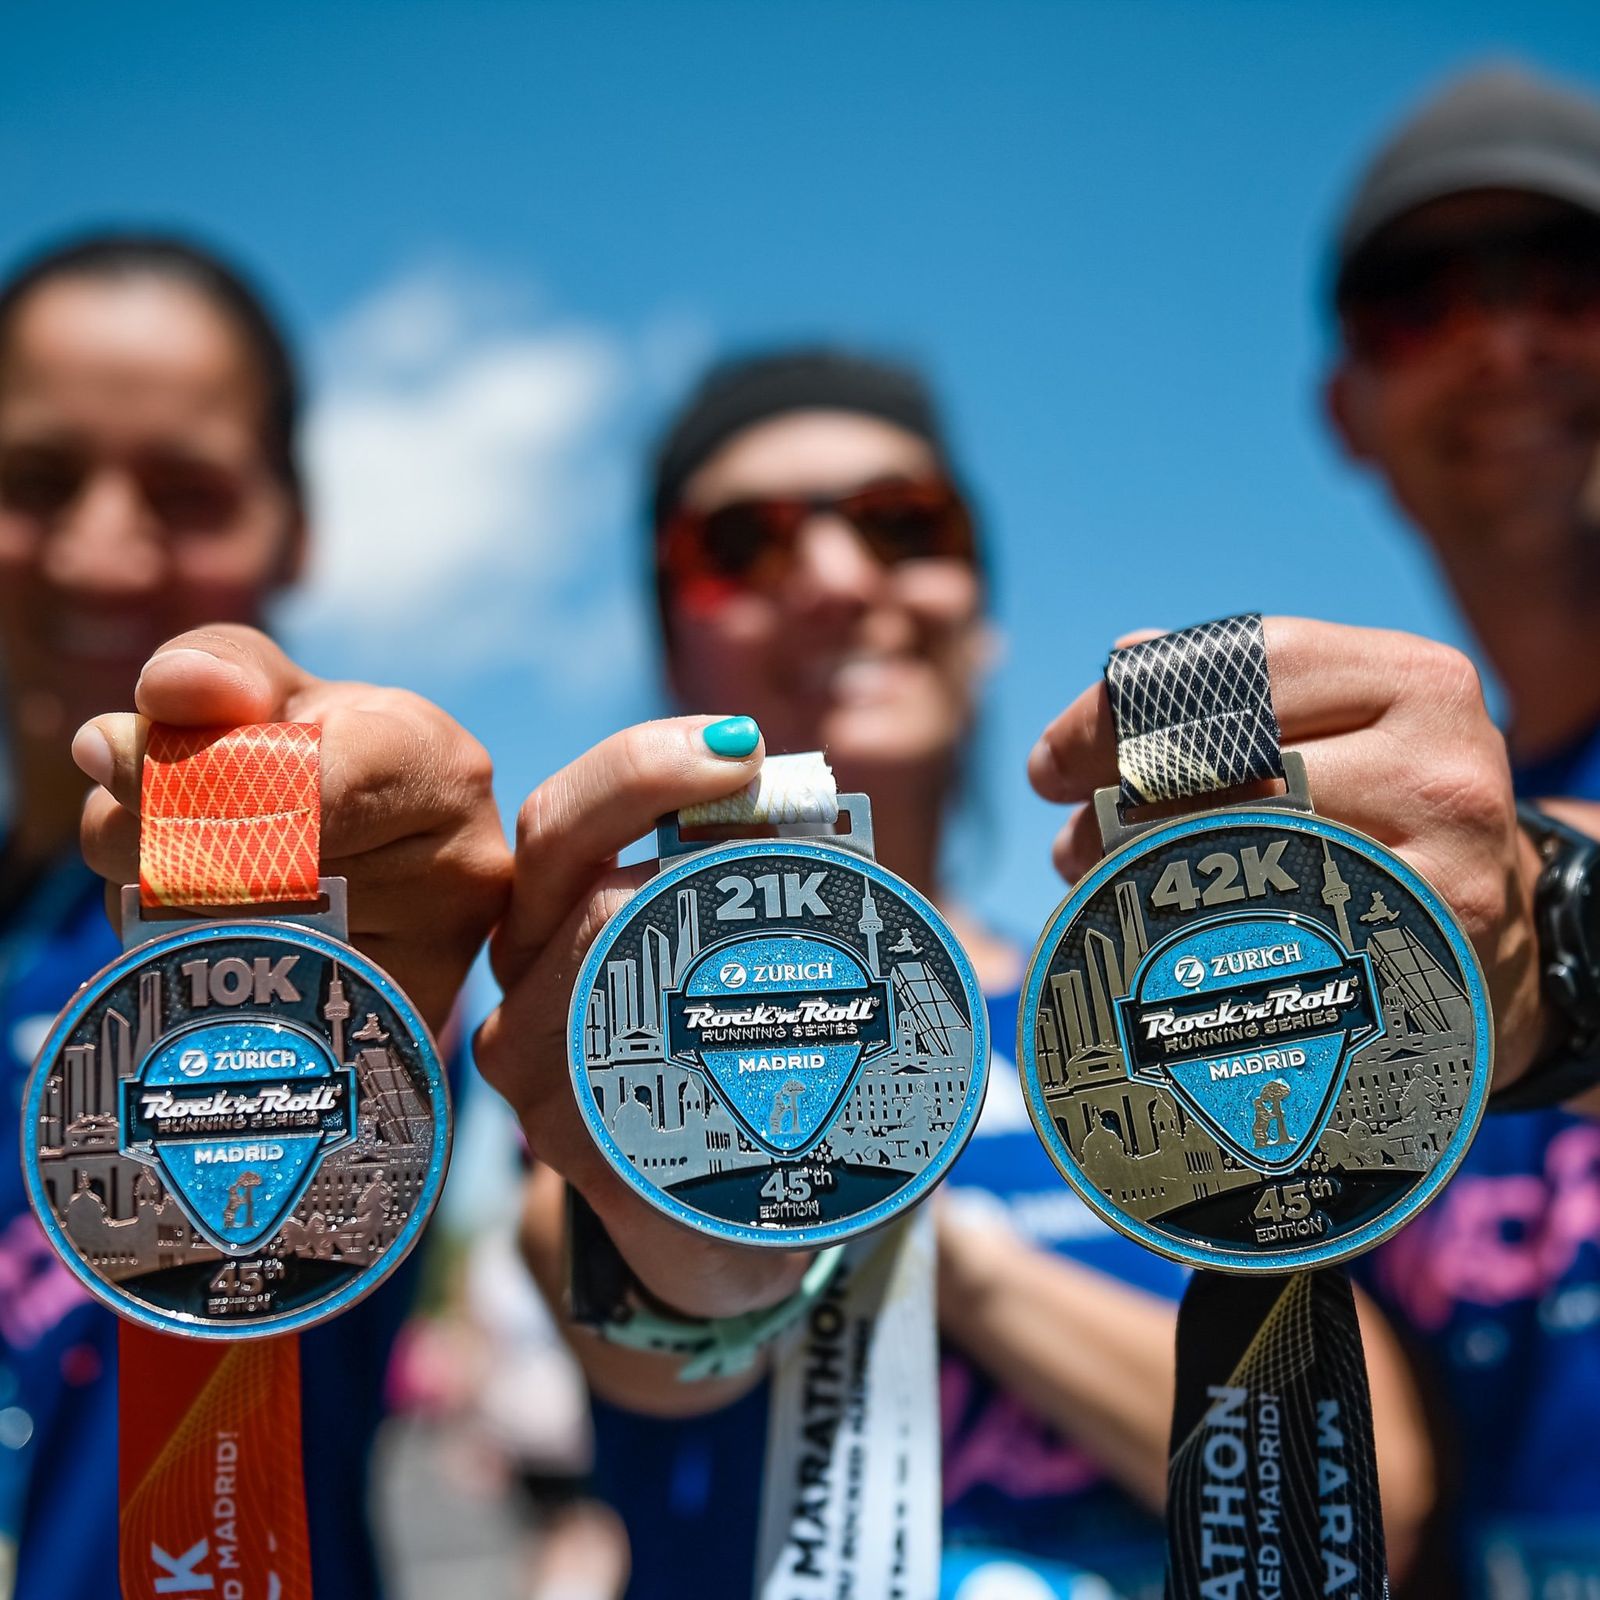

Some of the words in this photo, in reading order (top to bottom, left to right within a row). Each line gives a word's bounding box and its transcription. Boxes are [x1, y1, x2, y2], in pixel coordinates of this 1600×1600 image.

[1150, 839, 1299, 911] 42K
[715, 871, 832, 921] 21K
[752, 961, 834, 982] ZURICH
[1211, 942, 1303, 977] ZURICH
[181, 955, 302, 1008] 10K
[702, 1026, 787, 1042] RUNNING
[792, 1022, 858, 1038] SERIES
[1164, 1023, 1259, 1054] RUNNING
[1264, 1008, 1339, 1035] SERIES
[213, 1049, 297, 1071] ZURICH
[738, 1054, 826, 1074] MADRID
[1209, 1048, 1306, 1081] MADRID
[194, 1145, 284, 1164] MADRID
[760, 1165, 833, 1202] 45th
[1253, 1177, 1333, 1222] 45th
[760, 1200, 820, 1218] EDITION
[1255, 1216, 1323, 1243] EDITION
[1257, 1392, 1280, 1535] MADRID!
[214, 1431, 241, 1569] MADRID!
[1317, 1400, 1358, 1600] MARA
[151, 1537, 215, 1600] K
